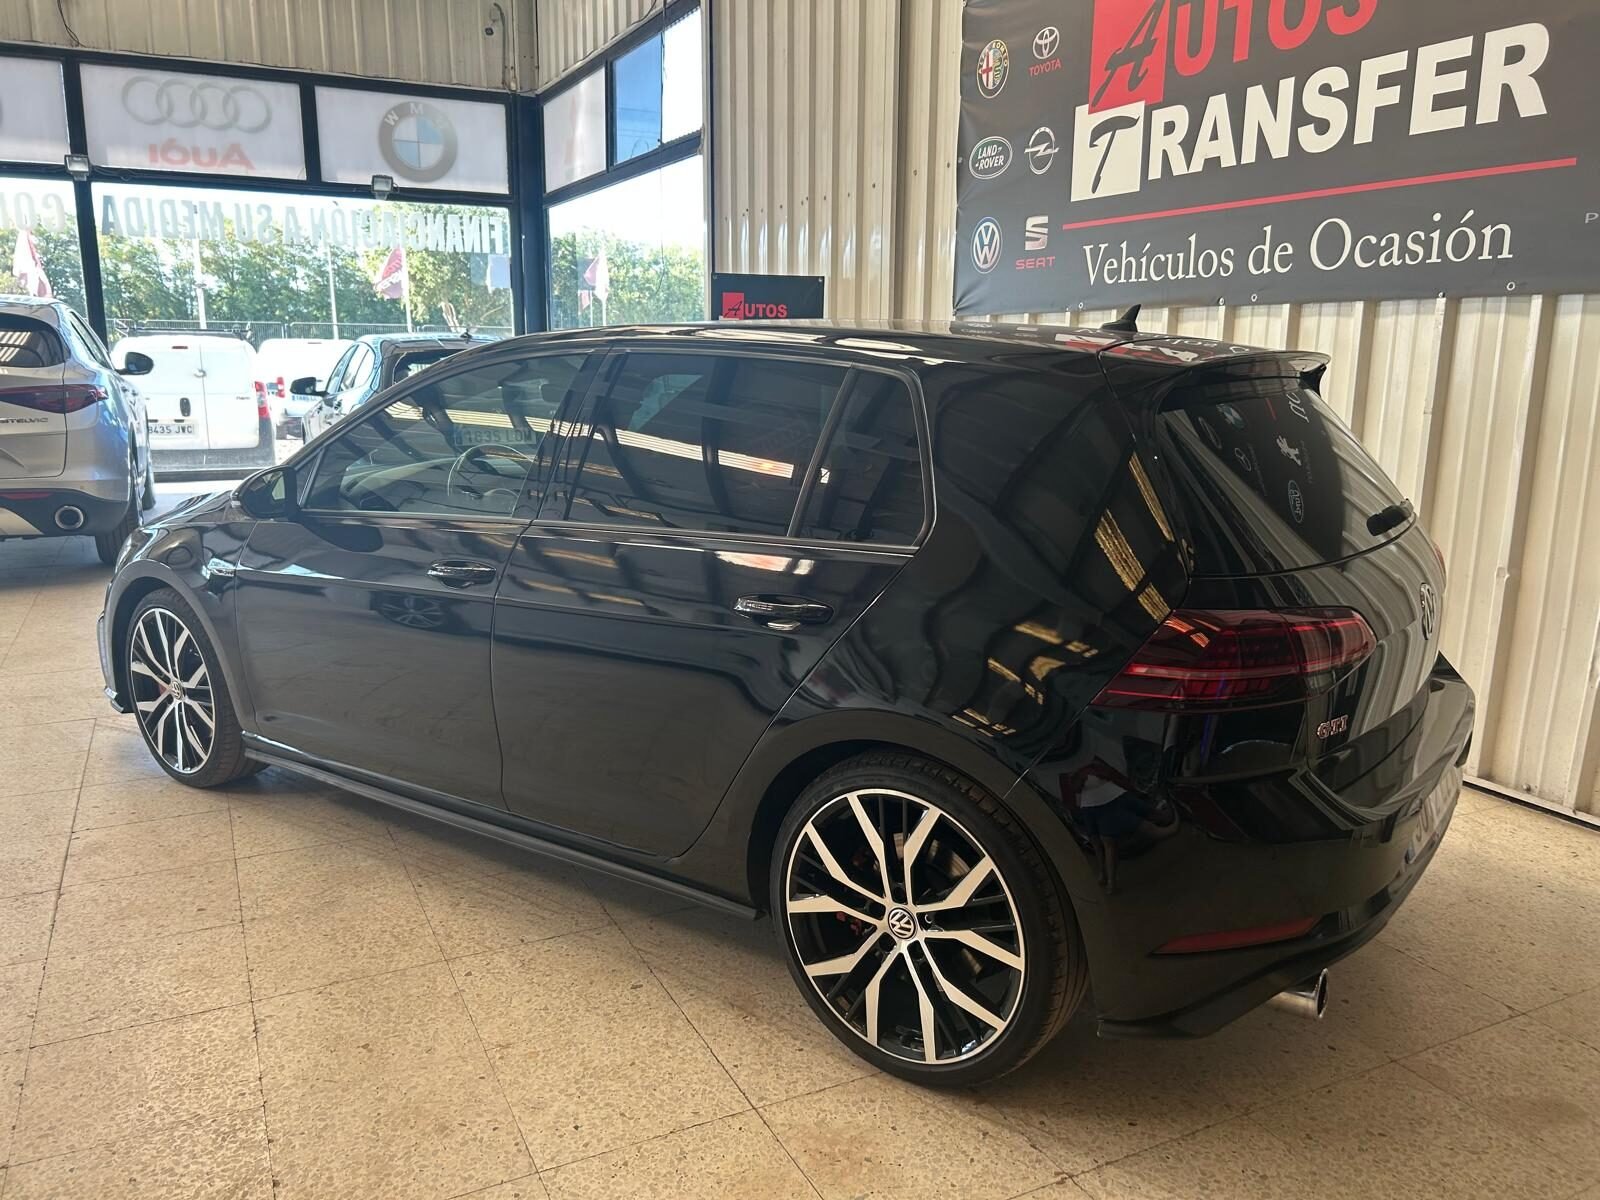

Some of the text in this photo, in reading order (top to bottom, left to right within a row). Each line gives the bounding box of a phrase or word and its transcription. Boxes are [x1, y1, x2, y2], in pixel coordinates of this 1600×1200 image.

[1028, 59, 1062, 77] TOYOTA
[1073, 23, 1549, 199] TRANSFER
[977, 144, 999, 160] LAND
[978, 155, 1005, 171] ROVER
[1082, 208, 1514, 288] Vehículos de Ocasión
[1015, 256, 1056, 270] SEAT
[722, 298, 789, 319] AUTOS
